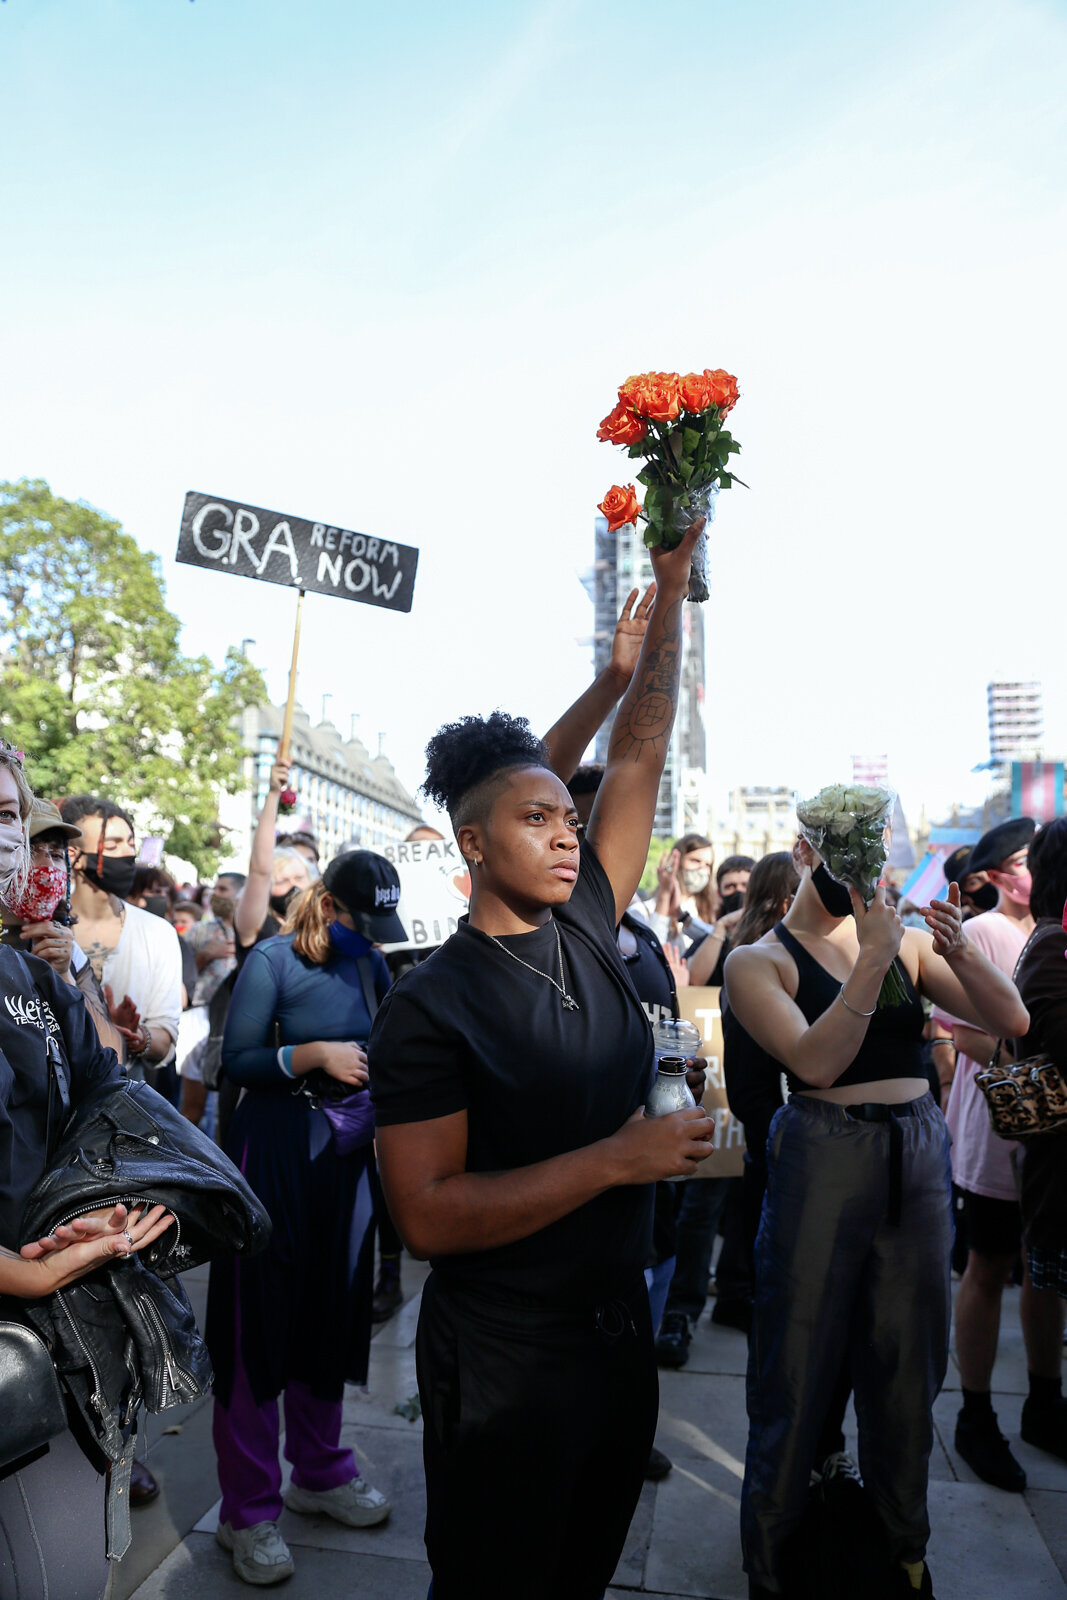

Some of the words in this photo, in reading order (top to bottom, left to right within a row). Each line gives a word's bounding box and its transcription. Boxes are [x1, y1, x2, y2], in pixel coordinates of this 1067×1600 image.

[310, 523, 399, 567] REFORM
[316, 552, 403, 600] NOW
[384, 841, 455, 863] BREAK
